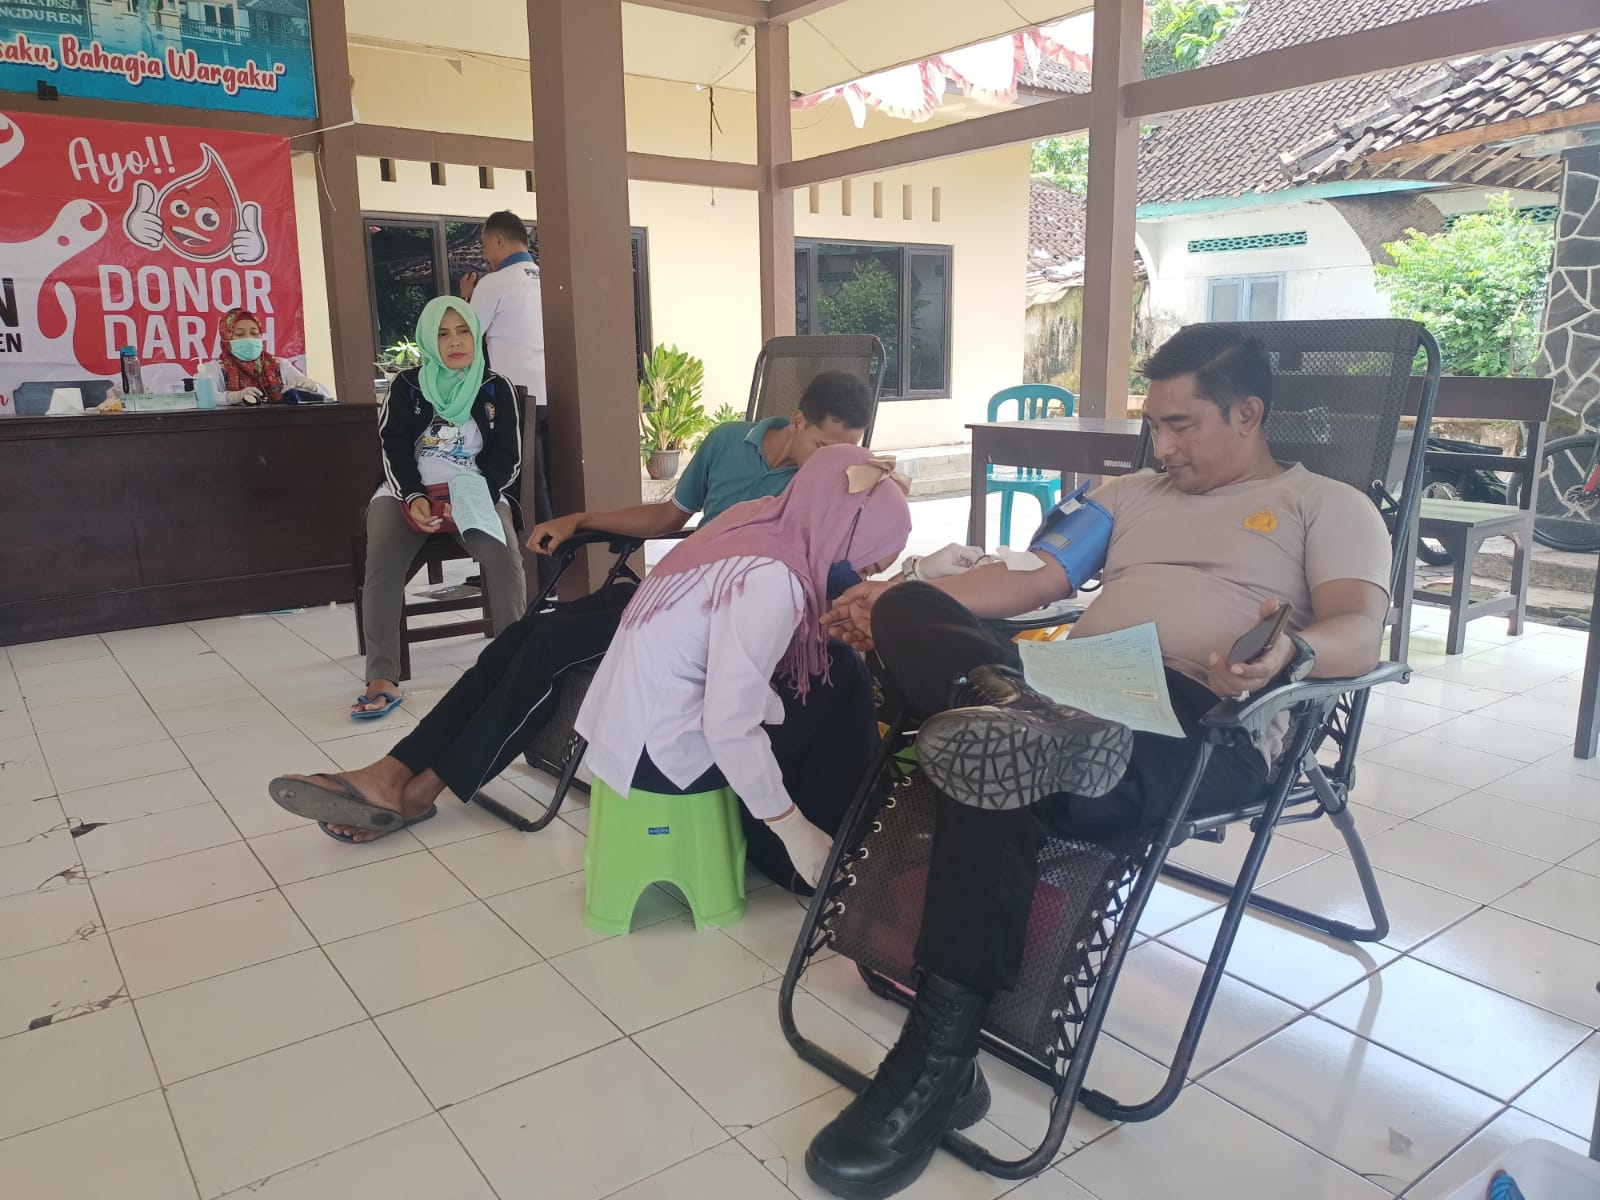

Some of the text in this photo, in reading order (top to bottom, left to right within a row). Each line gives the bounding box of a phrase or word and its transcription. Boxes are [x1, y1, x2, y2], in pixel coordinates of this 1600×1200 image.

[61, 35, 162, 83] Bahagia
[68, 135, 176, 193] Ayo!!
[98, 264, 275, 314] DONOR
